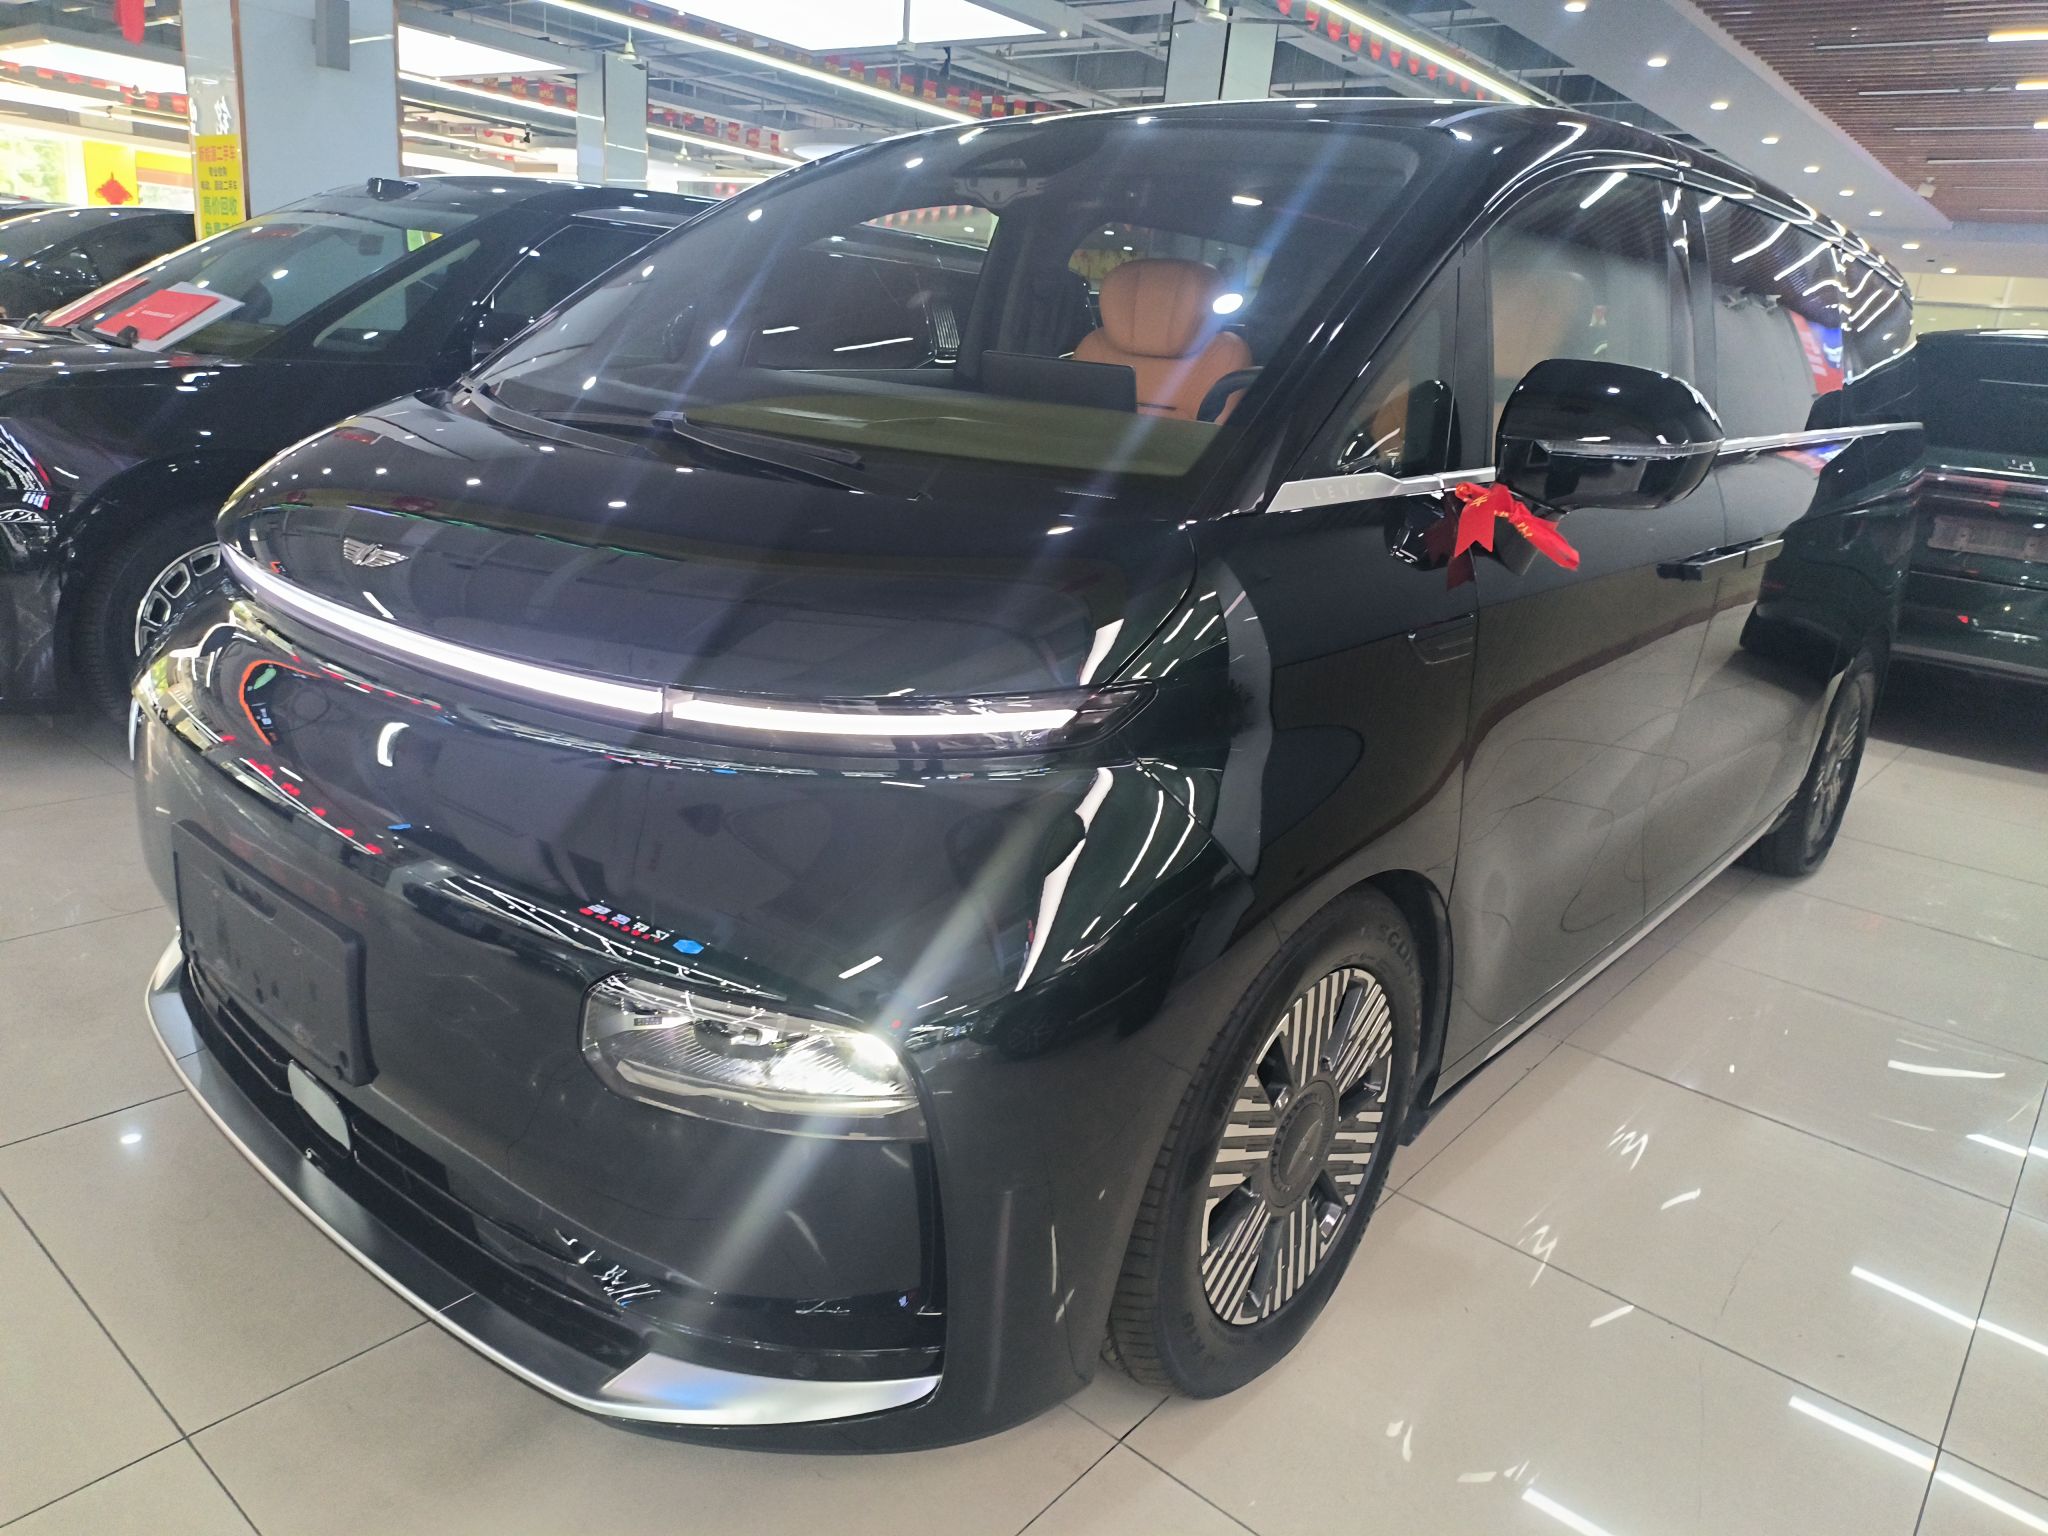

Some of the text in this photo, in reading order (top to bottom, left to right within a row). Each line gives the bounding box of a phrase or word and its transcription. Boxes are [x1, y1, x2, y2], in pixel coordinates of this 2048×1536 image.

[202, 196, 239, 216] 高价回收
[1311, 482, 1366, 500] LEVC
